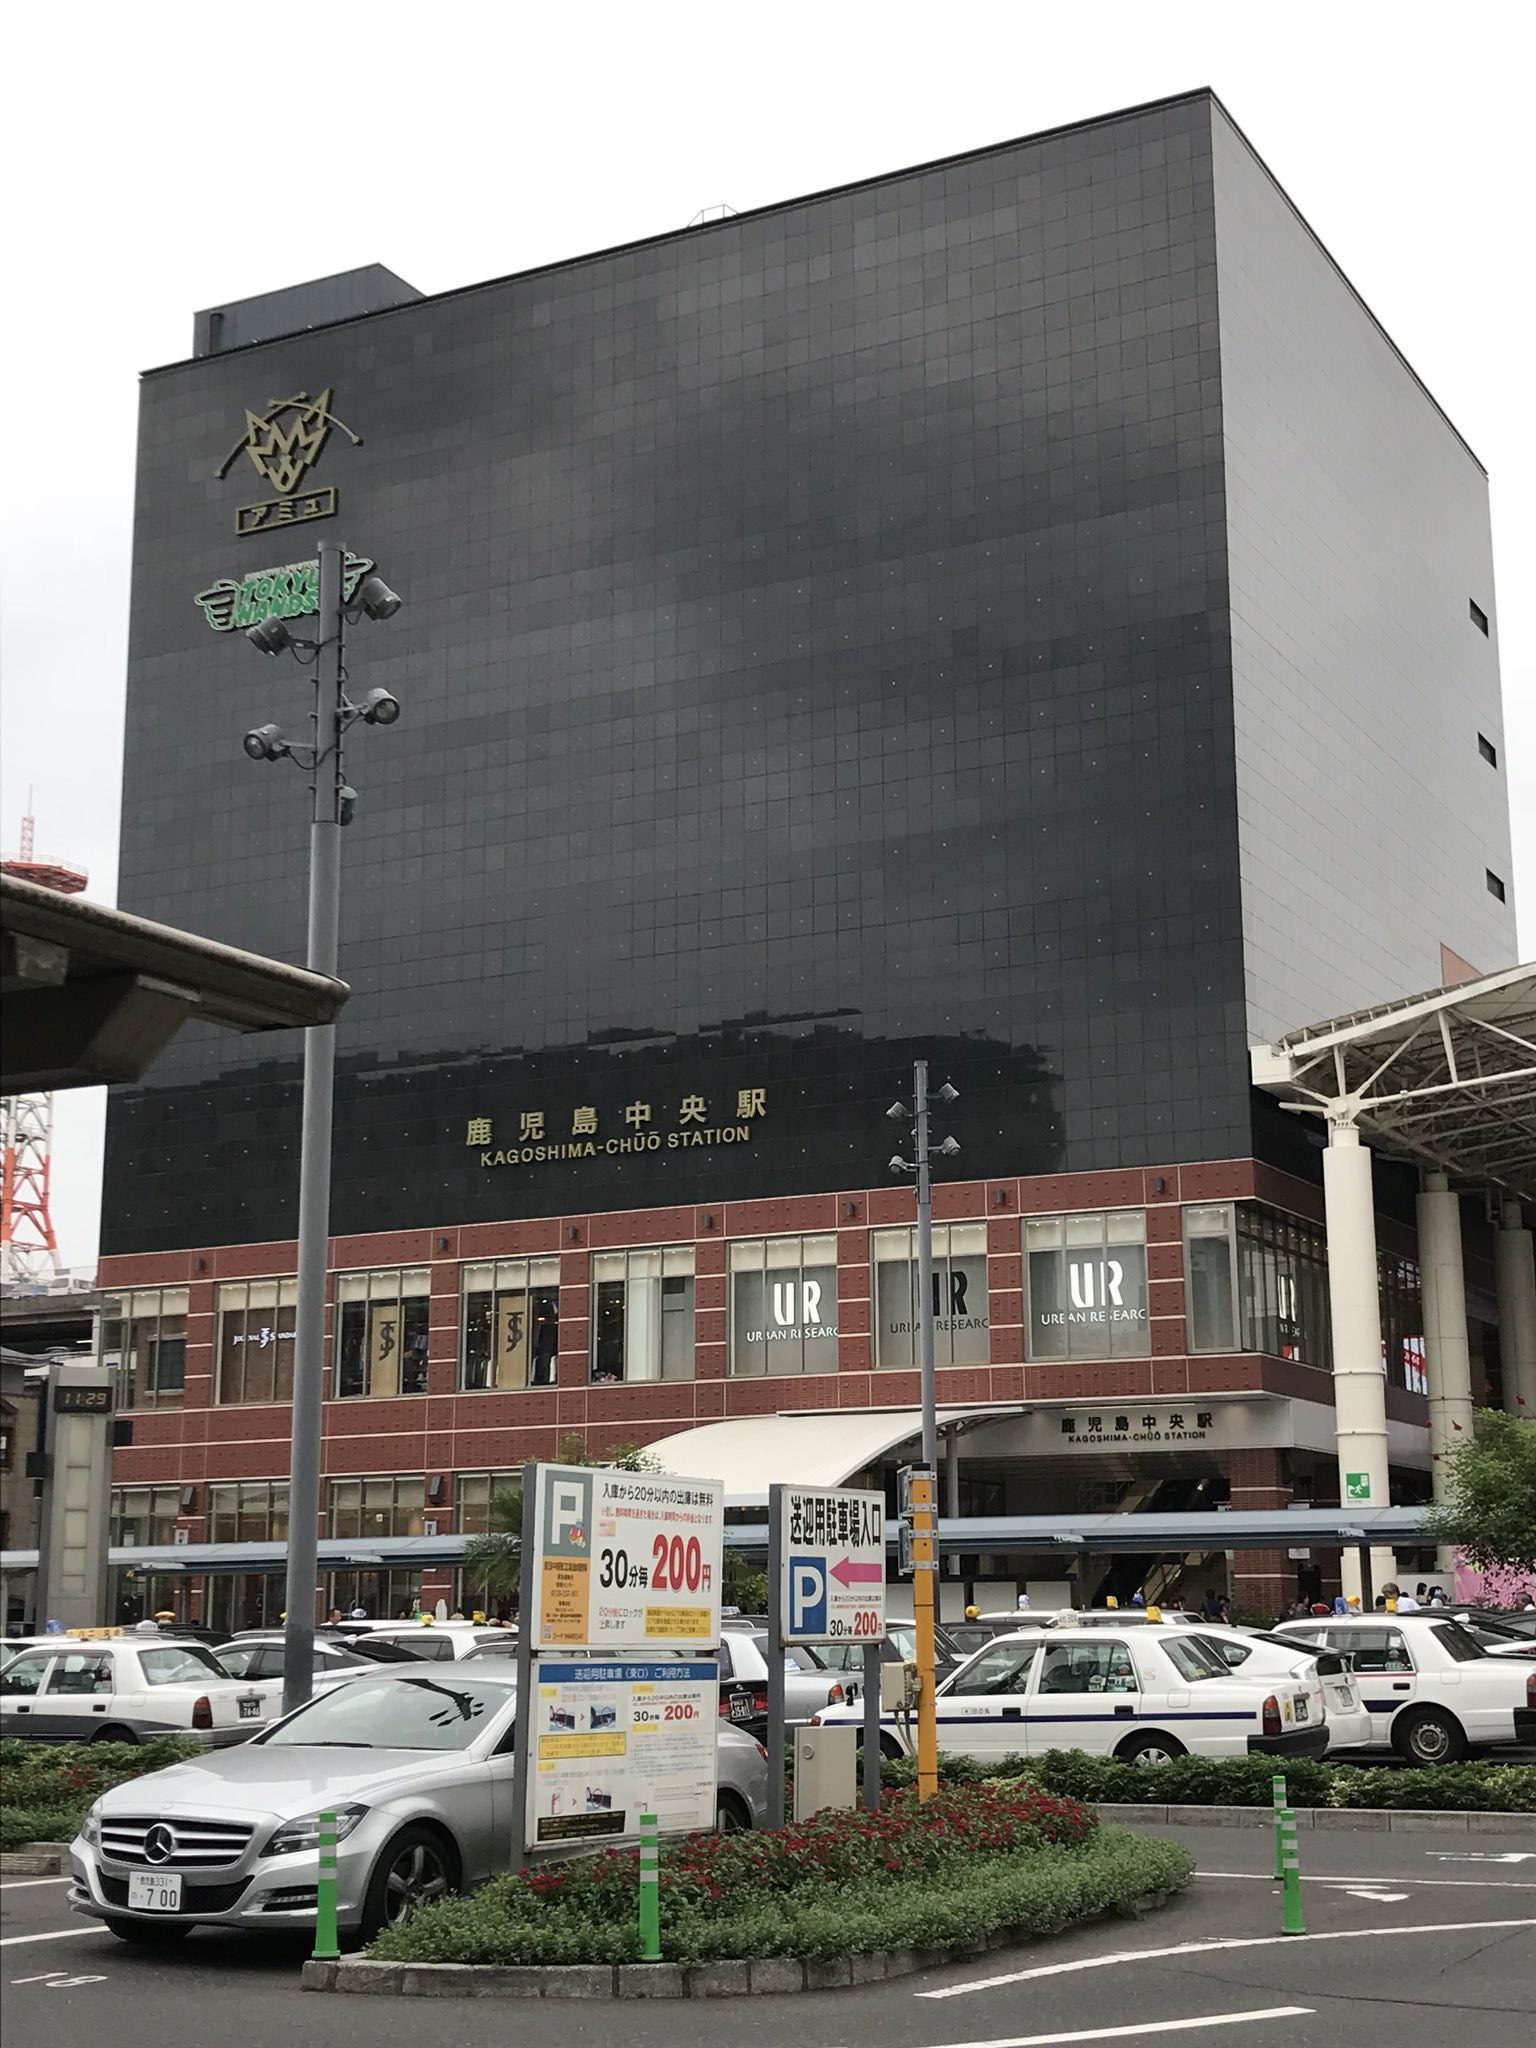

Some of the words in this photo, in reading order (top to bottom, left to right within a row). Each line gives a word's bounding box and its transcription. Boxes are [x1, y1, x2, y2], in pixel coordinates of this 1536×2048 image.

[466, 1088, 767, 1147] 鹿児島中央駅
[667, 1126, 750, 1149] STATION
[774, 1280, 821, 1326] UR
[1070, 1260, 1123, 1308] UR
[1090, 1309, 1146, 1322] REEARC
[1061, 1412, 1213, 1433] 鹿児島中央駅
[1164, 1431, 1206, 1440] STATION
[551, 1480, 585, 1545] P
[602, 1483, 714, 1507] 入庫から20分以内の出庫は無料
[790, 1495, 881, 1547] 送迎用駐車場入口
[600, 1548, 648, 1589] 30分毎
[652, 1533, 711, 1593] 200円
[793, 1565, 824, 1628] P
